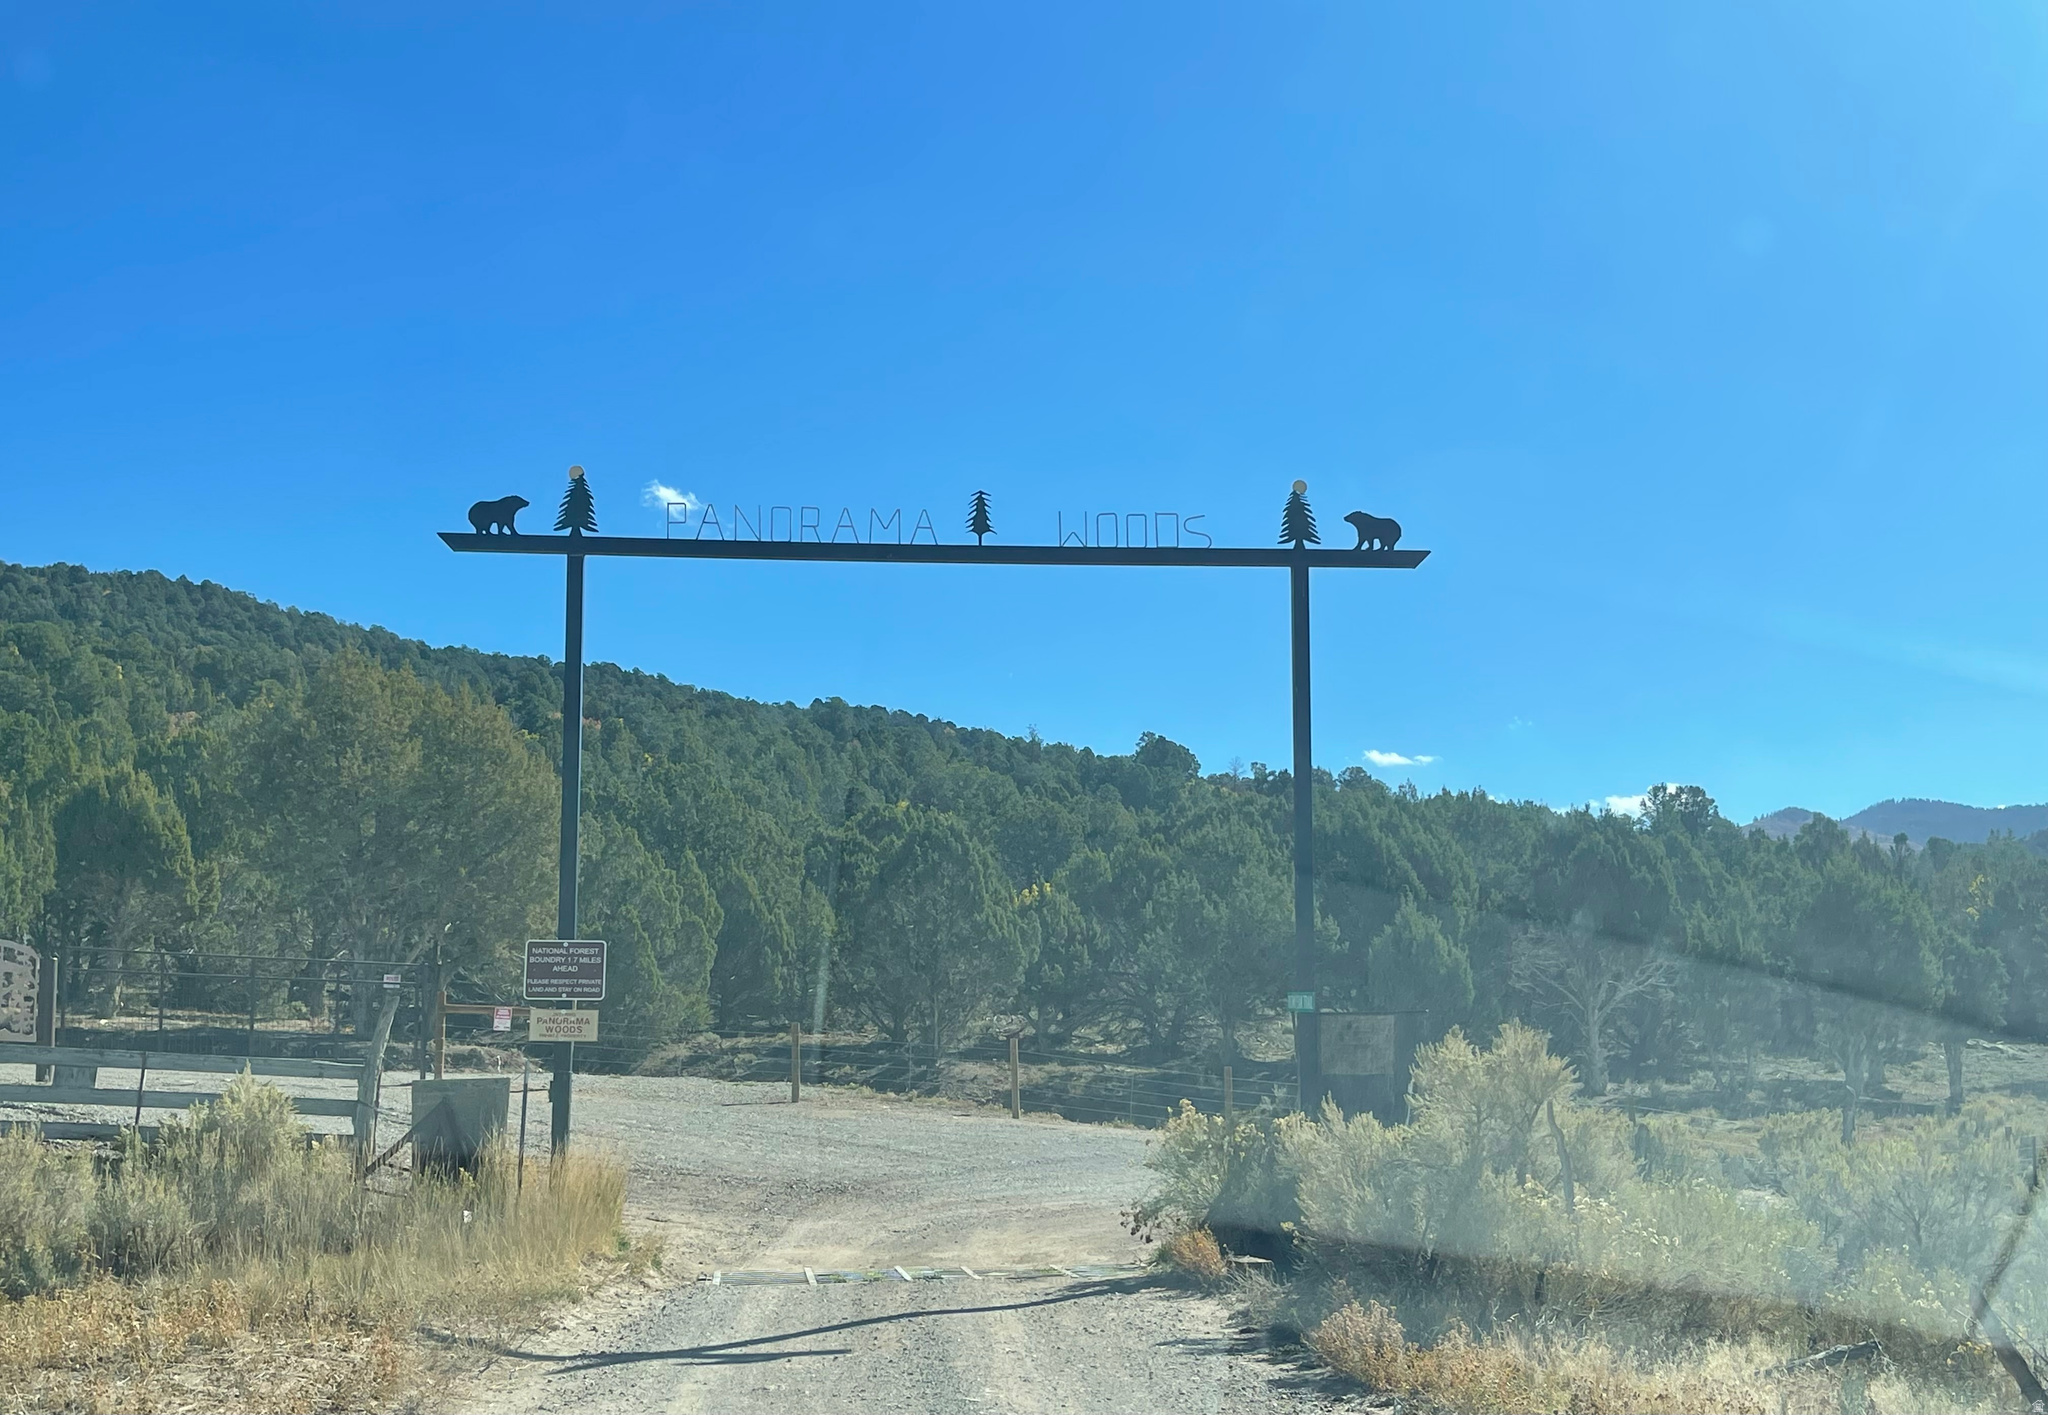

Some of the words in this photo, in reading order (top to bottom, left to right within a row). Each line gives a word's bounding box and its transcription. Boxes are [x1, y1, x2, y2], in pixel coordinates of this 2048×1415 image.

[667, 502, 938, 545] PANORAMA
[1058, 510, 1212, 549] WOODS
[532, 947, 568, 955] NATIONAL
[569, 947, 600, 955] FOREST
[529, 956, 566, 964] BOUNDRY
[579, 956, 602, 964] MILES
[545, 1025, 583, 1034] WOODS
